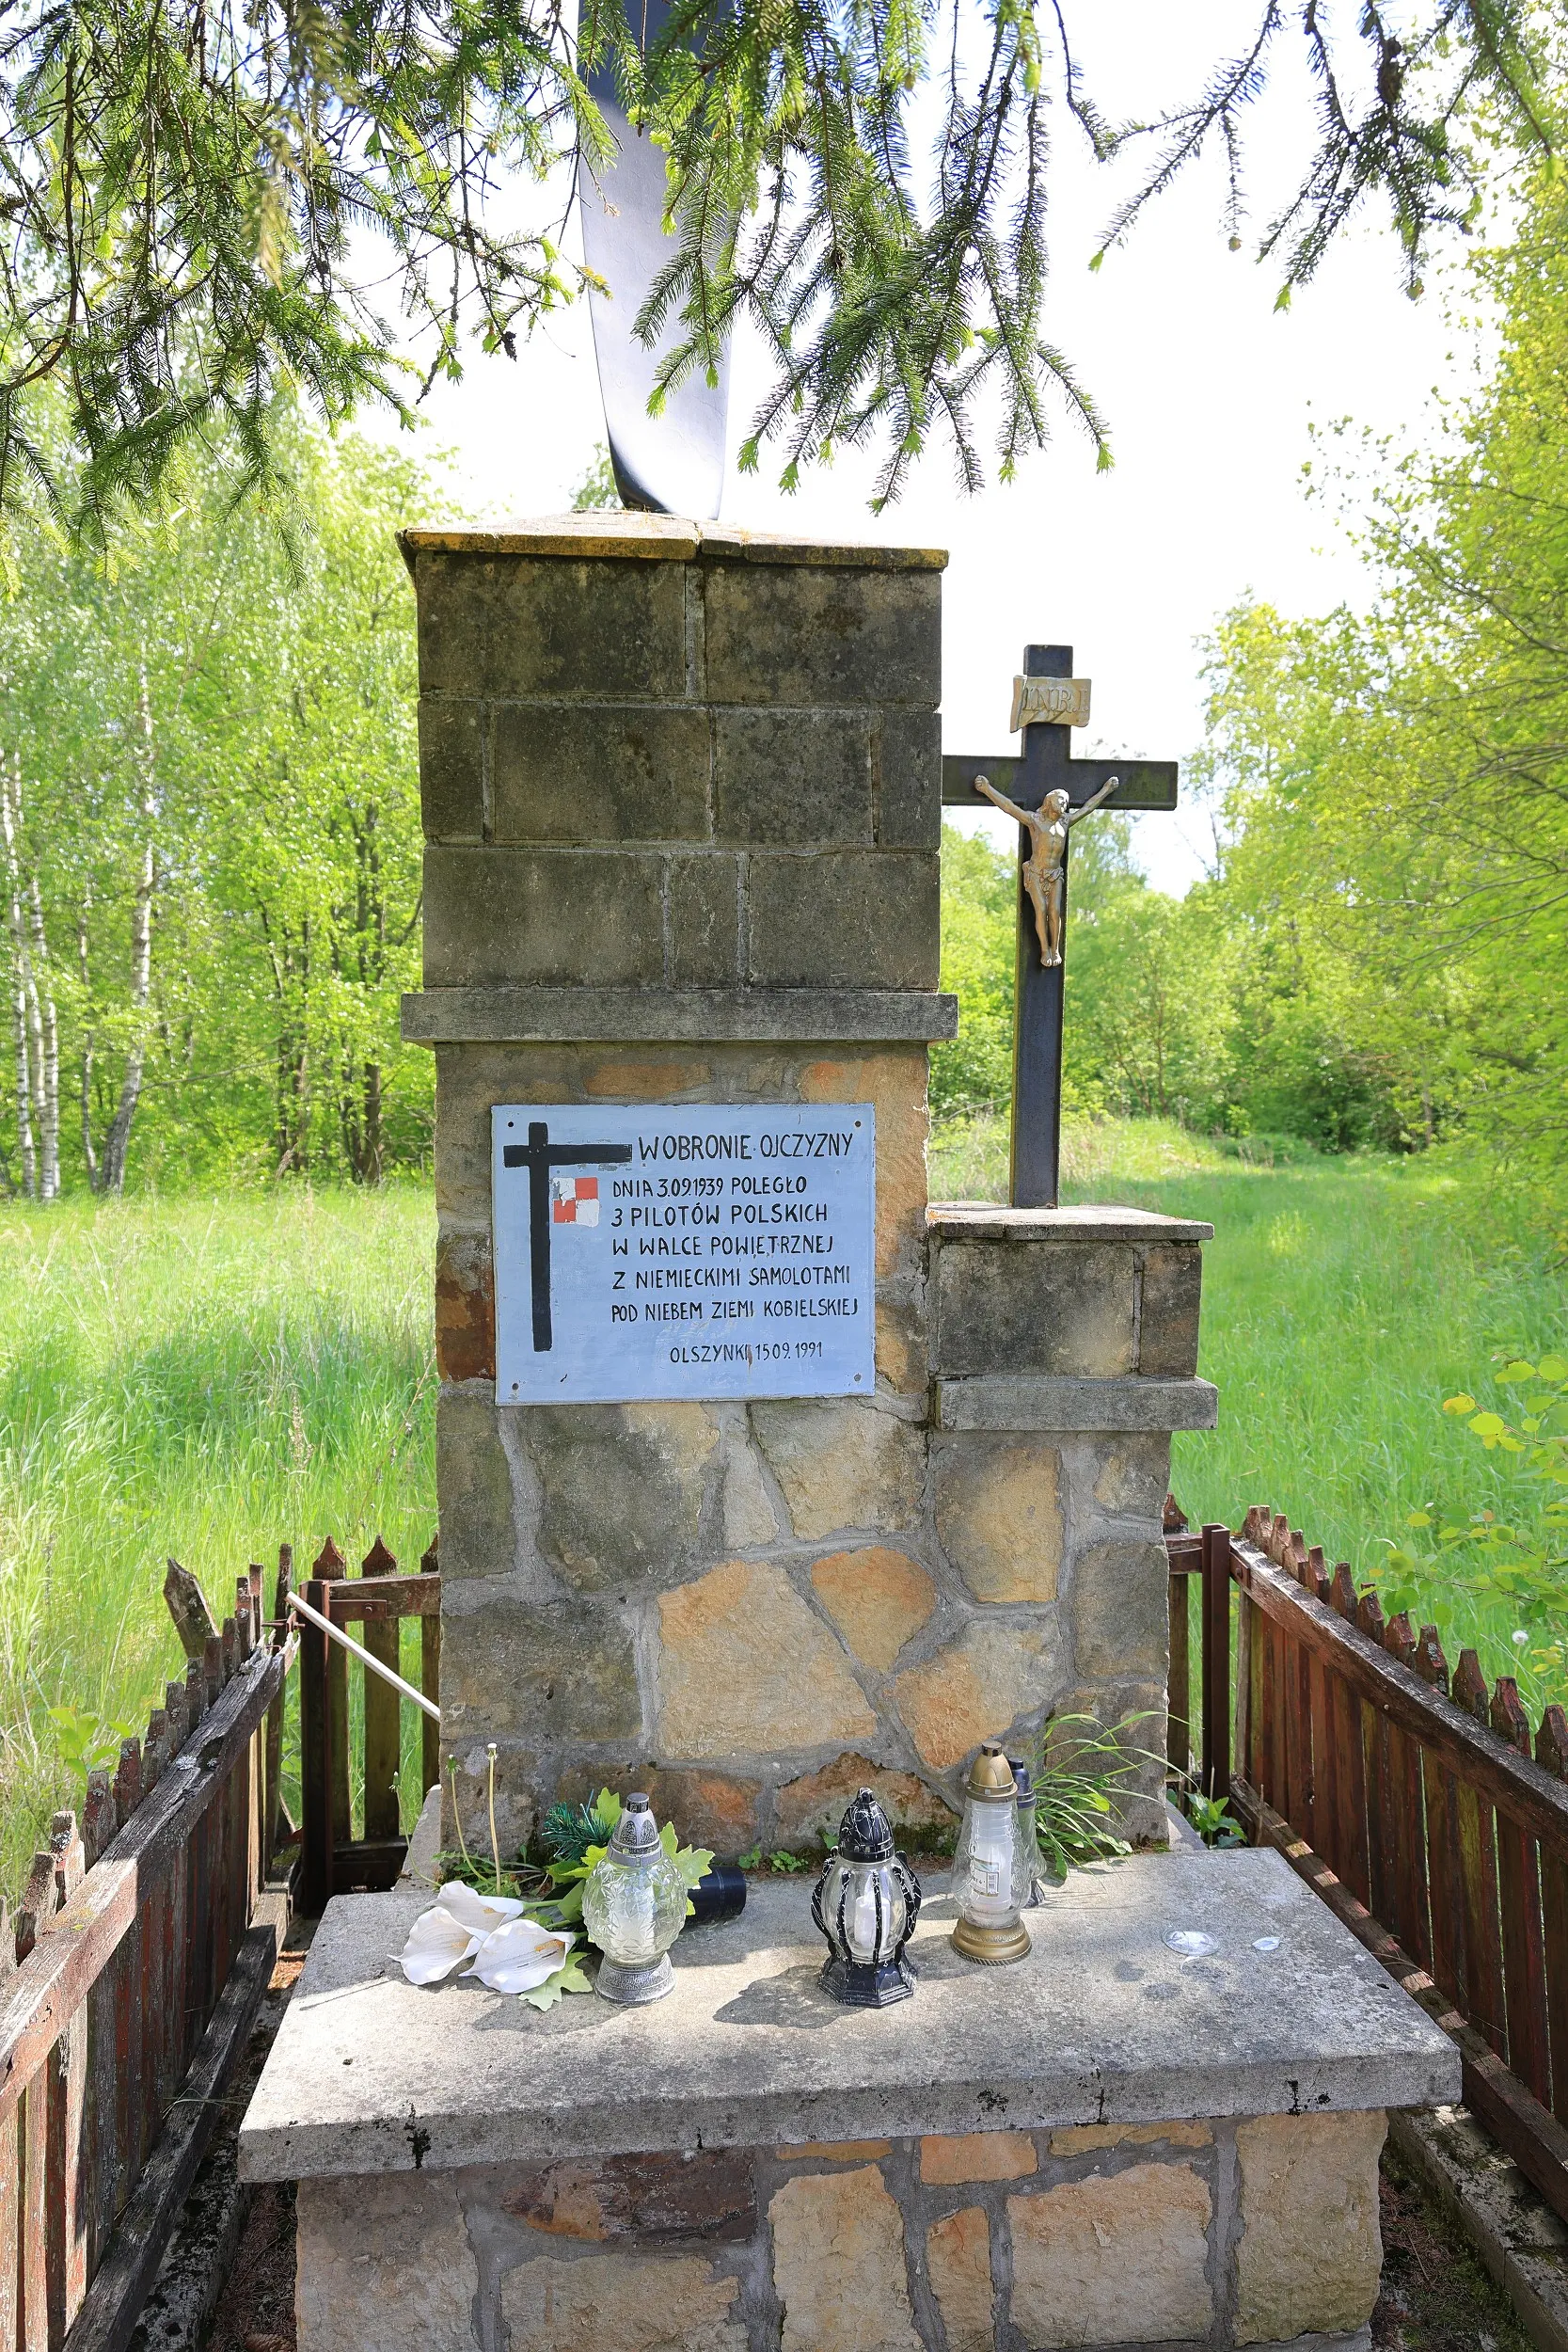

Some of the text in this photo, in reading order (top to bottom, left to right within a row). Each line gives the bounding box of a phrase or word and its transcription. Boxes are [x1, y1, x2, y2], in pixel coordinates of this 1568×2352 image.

[759, 1132, 853, 1158] OJCZYZNY
[612, 1179, 654, 1199] DNIA
[731, 1175, 807, 1196] POLEGŁO
[610, 1201, 828, 1228] 3 PILOTÓW POLSKICH
[612, 1237, 628, 1256] W
[639, 1235, 703, 1256] WALCE
[611, 1264, 850, 1290] Z NIEMIECKIMI SAMOLOTAMI
[610, 1297, 858, 1324] POD NIEBEM ZIEMI KOBIELSKIEJ
[670, 1343, 749, 1363] OLSZYNKI
